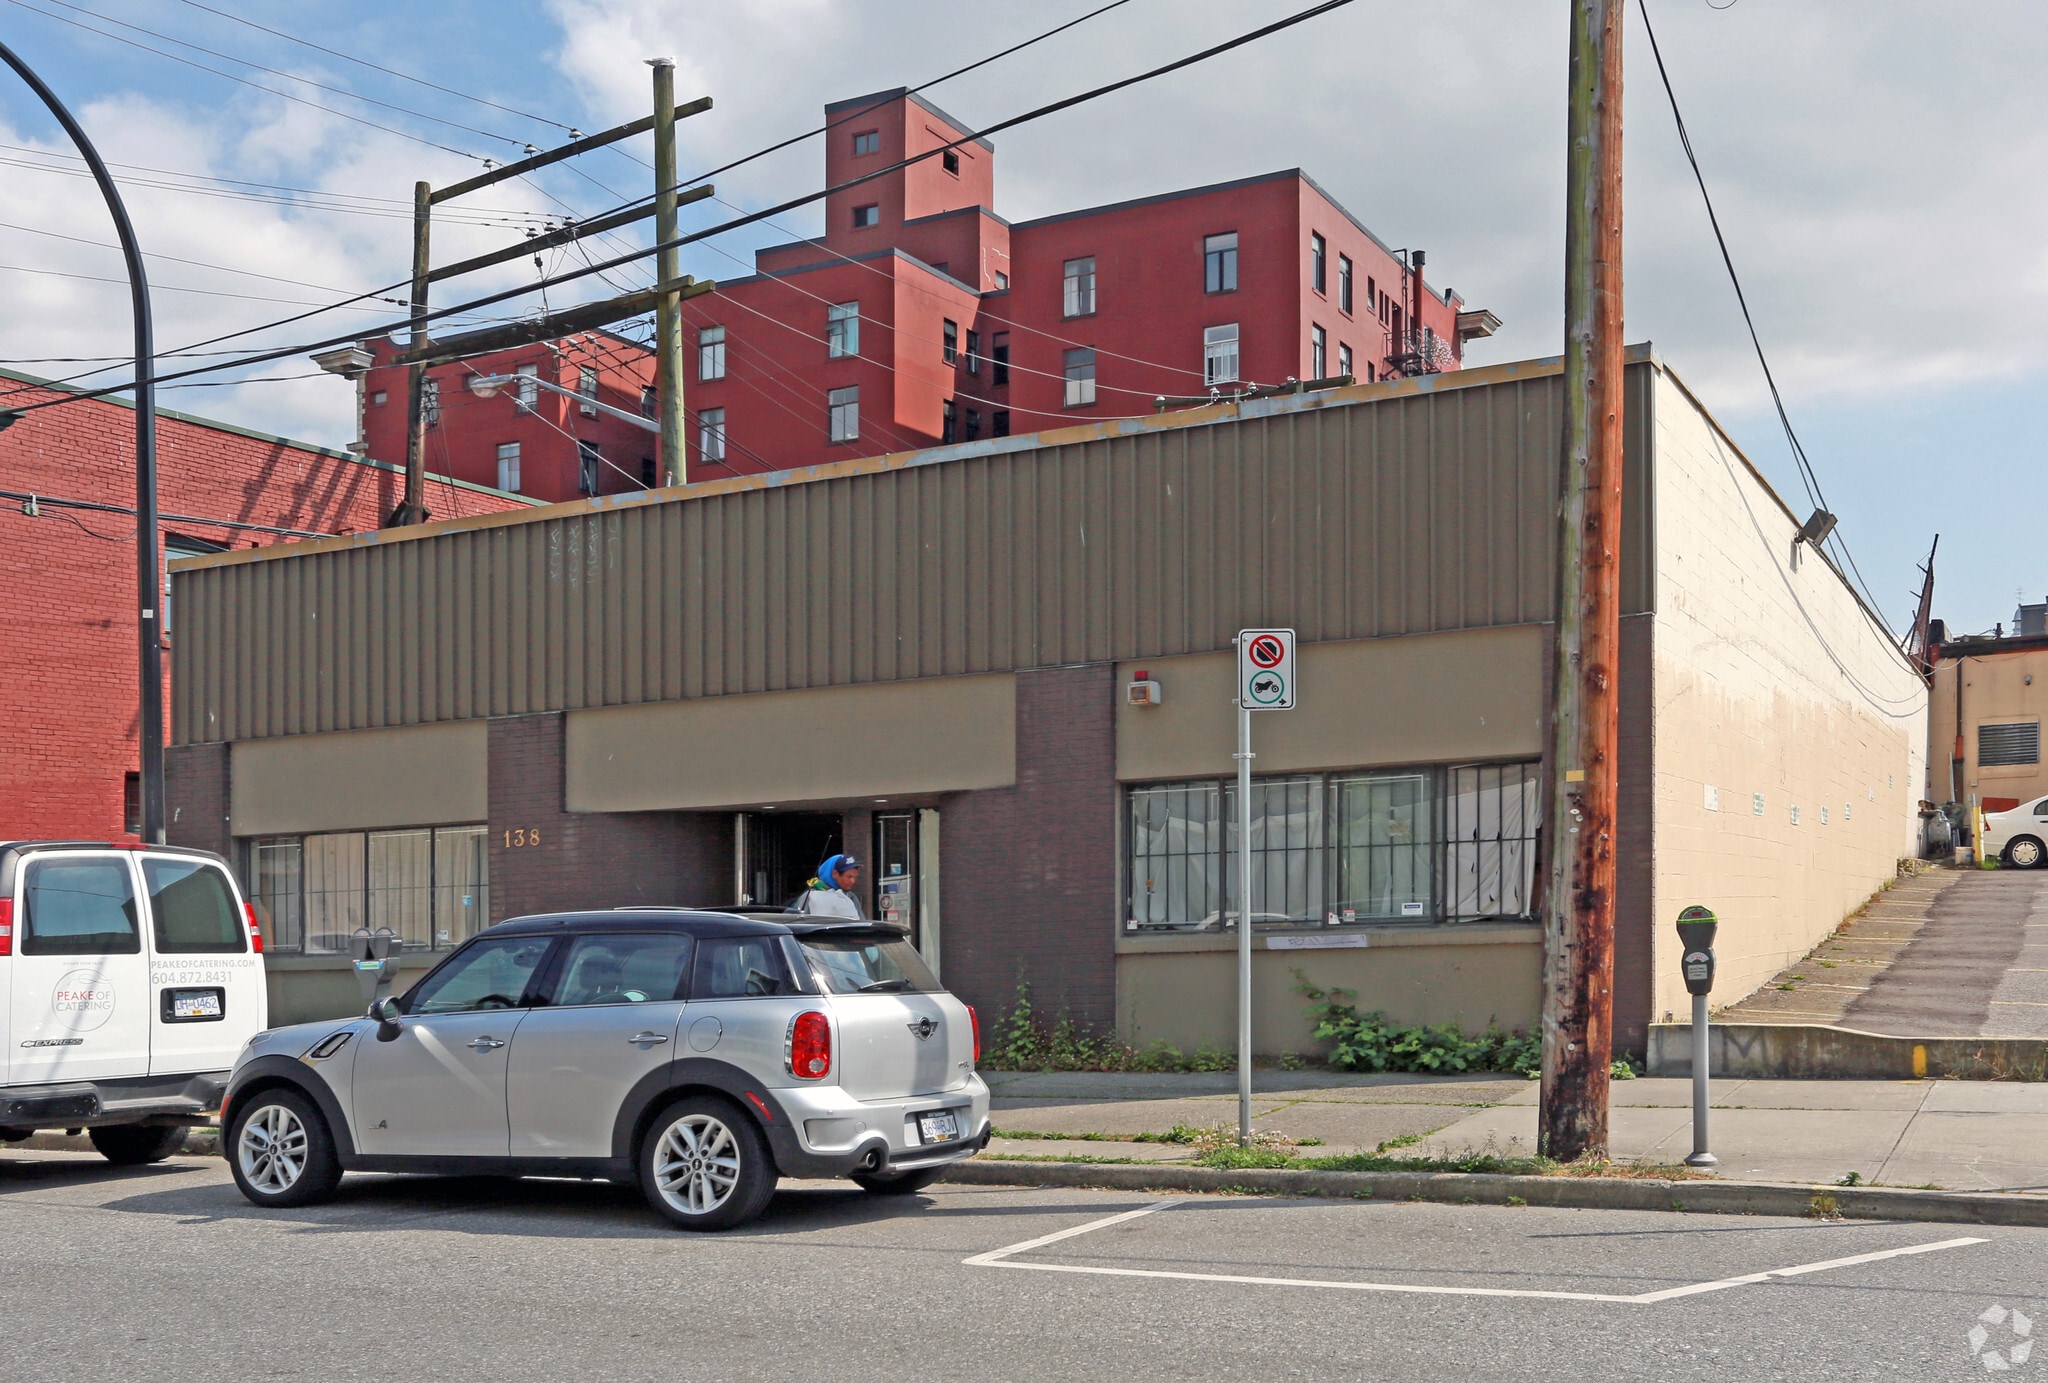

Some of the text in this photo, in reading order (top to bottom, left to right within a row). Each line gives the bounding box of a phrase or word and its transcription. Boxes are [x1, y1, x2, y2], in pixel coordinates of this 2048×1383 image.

[504, 829, 540, 848] 138
[151, 960, 256, 969] PEAKEOFCATERING.COM
[152, 972, 232, 984] 604.872.8431
[57, 991, 111, 1001] PEAKE OF
[56, 1001, 111, 1011] CATERING
[34, 1039, 83, 1047] EXPRESS
